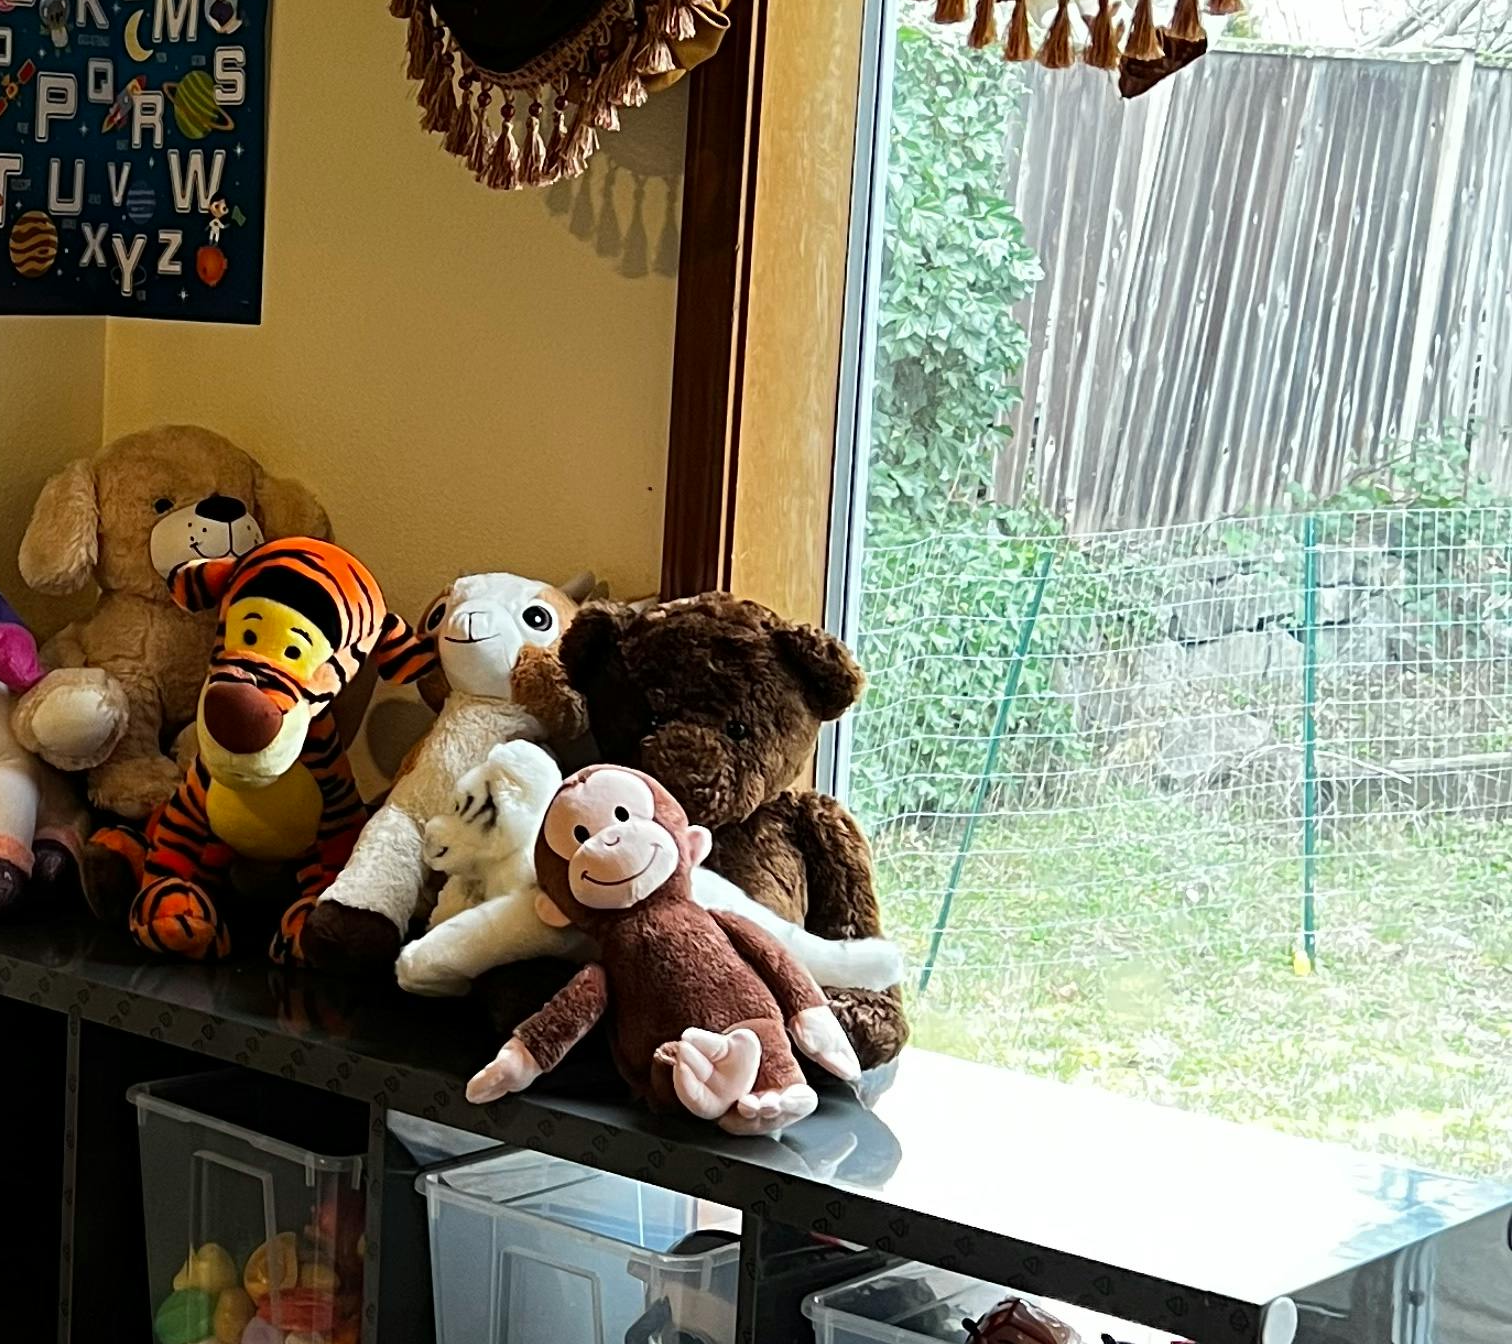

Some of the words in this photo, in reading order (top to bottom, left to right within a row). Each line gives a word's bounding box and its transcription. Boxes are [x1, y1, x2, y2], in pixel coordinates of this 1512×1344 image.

[35, 71, 78, 142] P
[87, 57, 114, 104] Q
[131, 90, 164, 149] R
[213, 45, 246, 105] S
[48, 157, 85, 216] U
[107, 161, 131, 207] V
[167, 148, 226, 214] W
[79, 222, 109, 267] X
[112, 233, 147, 297] Y
[157, 229, 182, 275] Z
